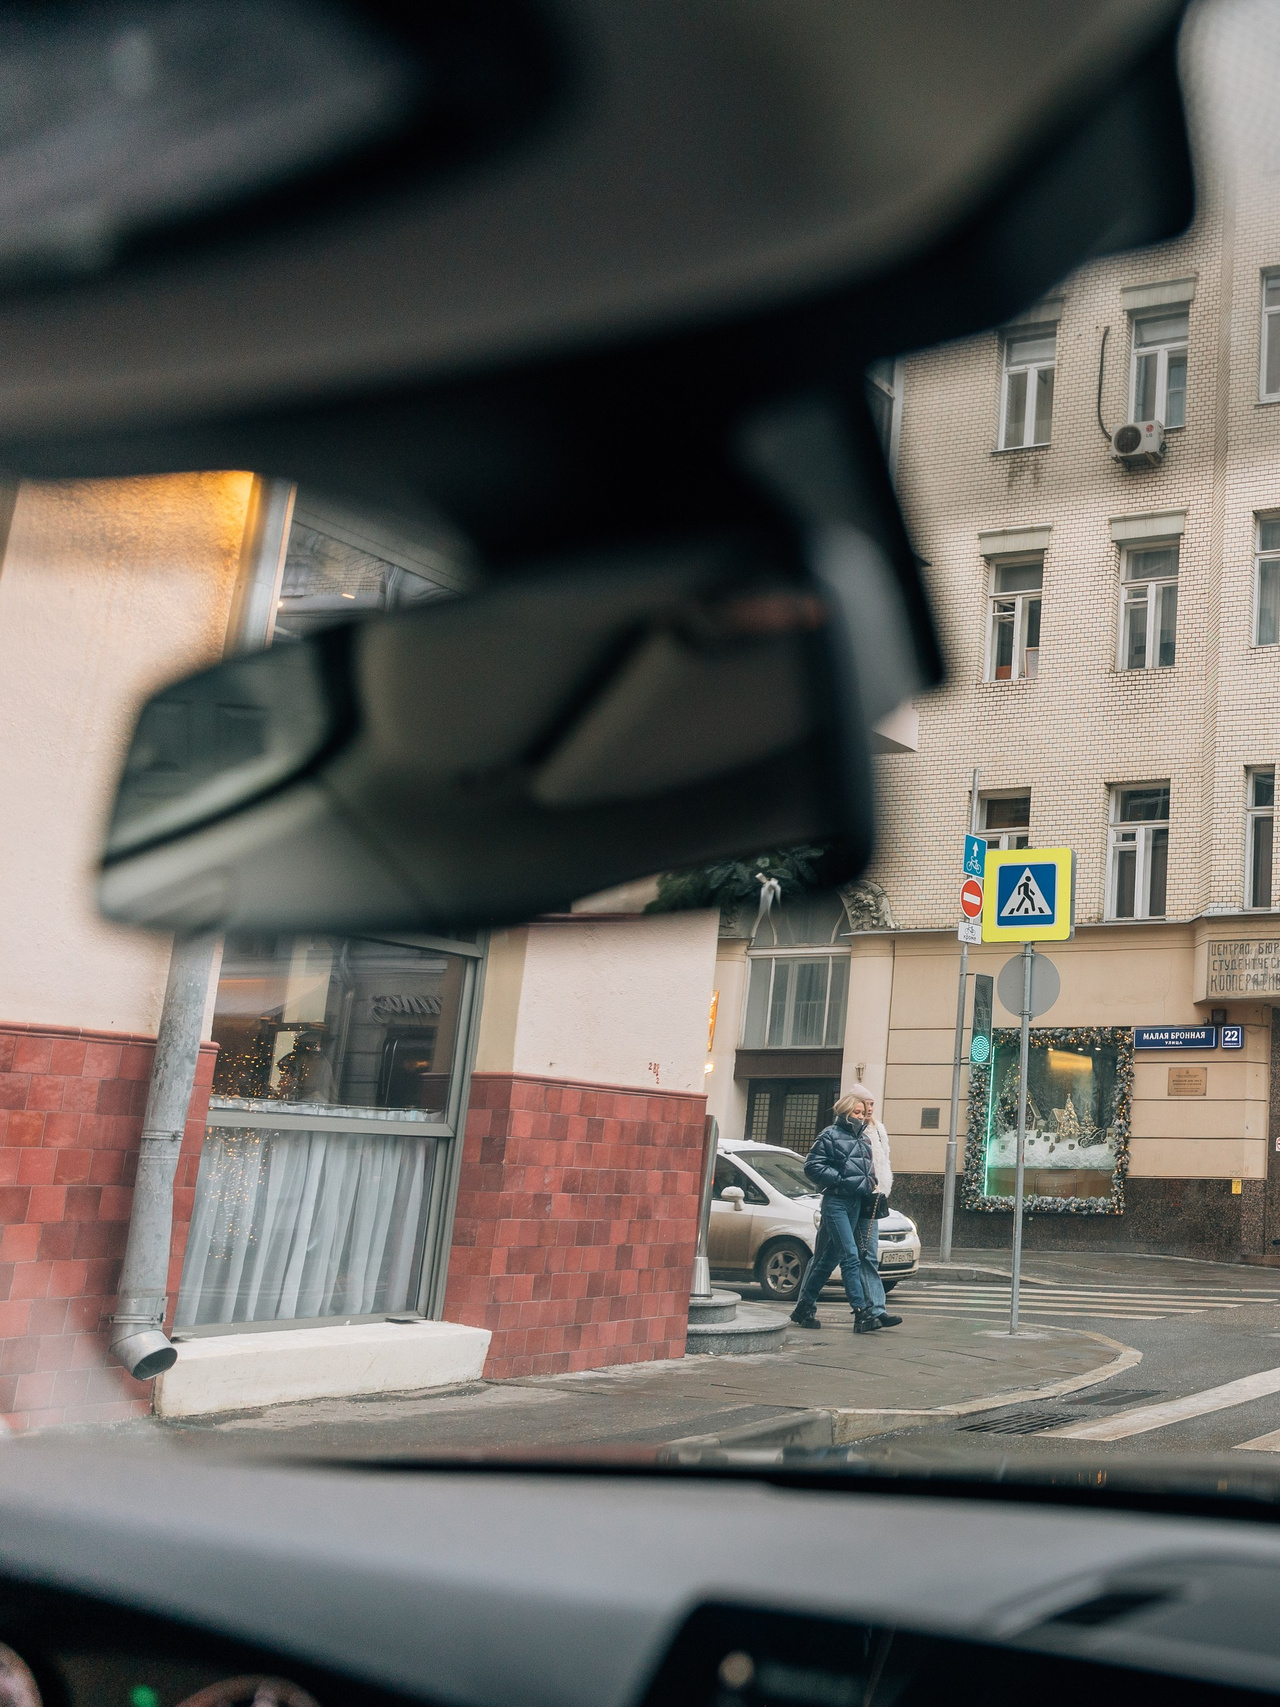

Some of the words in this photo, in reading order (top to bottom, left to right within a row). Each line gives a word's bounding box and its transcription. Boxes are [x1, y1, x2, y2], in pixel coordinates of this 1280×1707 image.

[1143, 1032, 1169, 1040] МАЛАЯ
[1171, 1031, 1206, 1040] БРОННАЯ
[1224, 1030, 1238, 1041] 22
